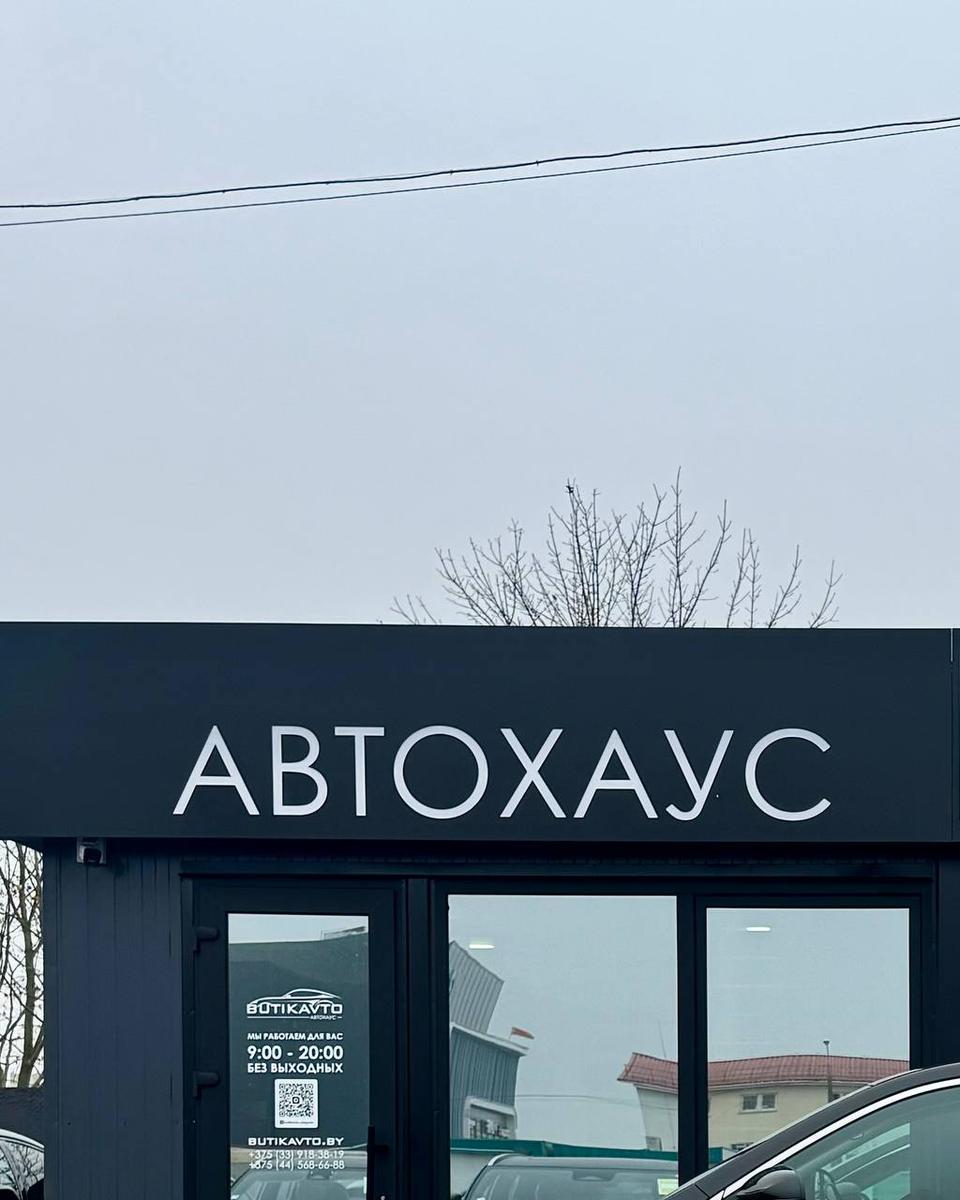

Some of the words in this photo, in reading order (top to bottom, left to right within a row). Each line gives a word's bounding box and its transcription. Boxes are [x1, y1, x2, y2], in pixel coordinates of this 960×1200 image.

[172, 725, 832, 822] АВТОХАУС
[246, 1003, 343, 1015] BUTIKAVTO
[307, 1033, 324, 1041] ДЛЯ
[247, 1045, 282, 1060] 9:00
[298, 1045, 344, 1060] 20:00
[247, 1063, 267, 1073] БЕЗ
[271, 1063, 343, 1074] ВЫХОДНЫХ
[248, 1137, 344, 1146] BUTIKAVTO.BY
[249, 1150, 273, 1159] +375
[275, 1150, 294, 1160] (33)
[296, 1150, 345, 1159] 918-38-19
[275, 1160, 294, 1171] (44)
[296, 1160, 345, 1169] 568-66-88
